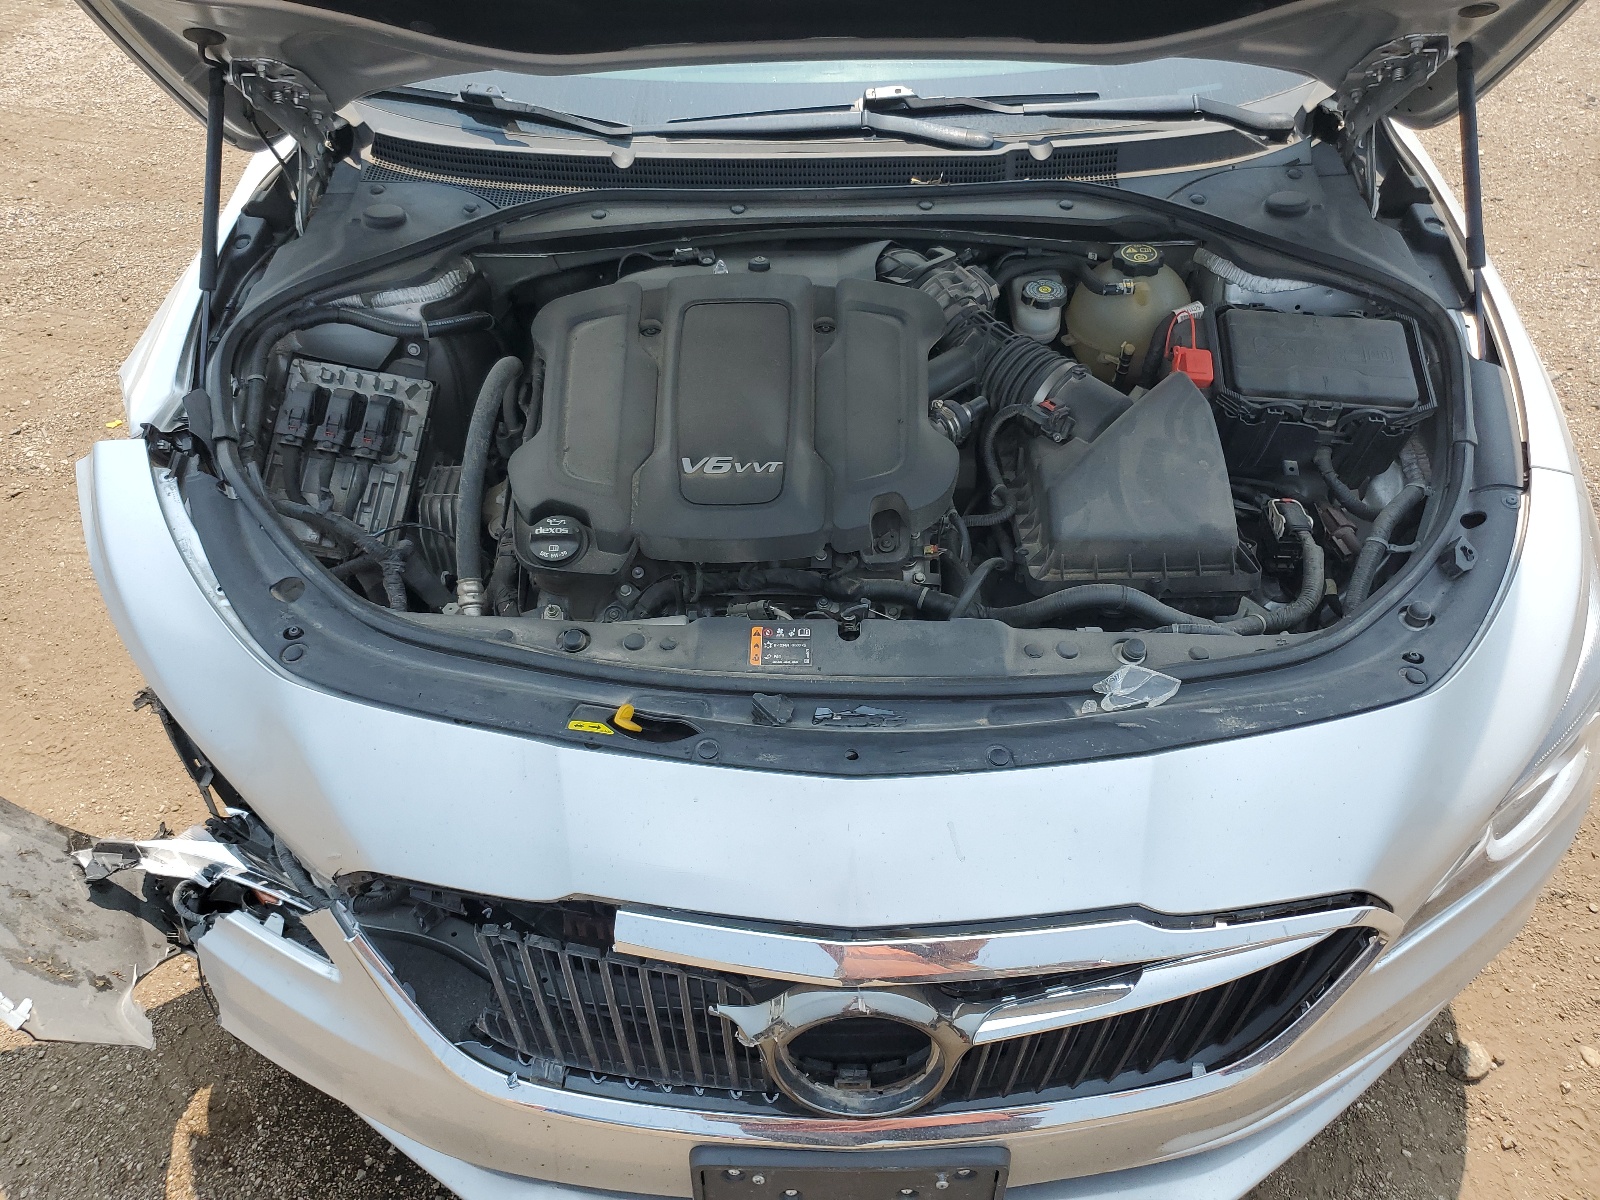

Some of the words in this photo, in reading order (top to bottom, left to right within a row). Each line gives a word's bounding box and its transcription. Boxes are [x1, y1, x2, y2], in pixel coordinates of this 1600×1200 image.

[681, 456, 733, 474] V6
[734, 461, 784, 473] VVT
[534, 526, 569, 535] dexos
